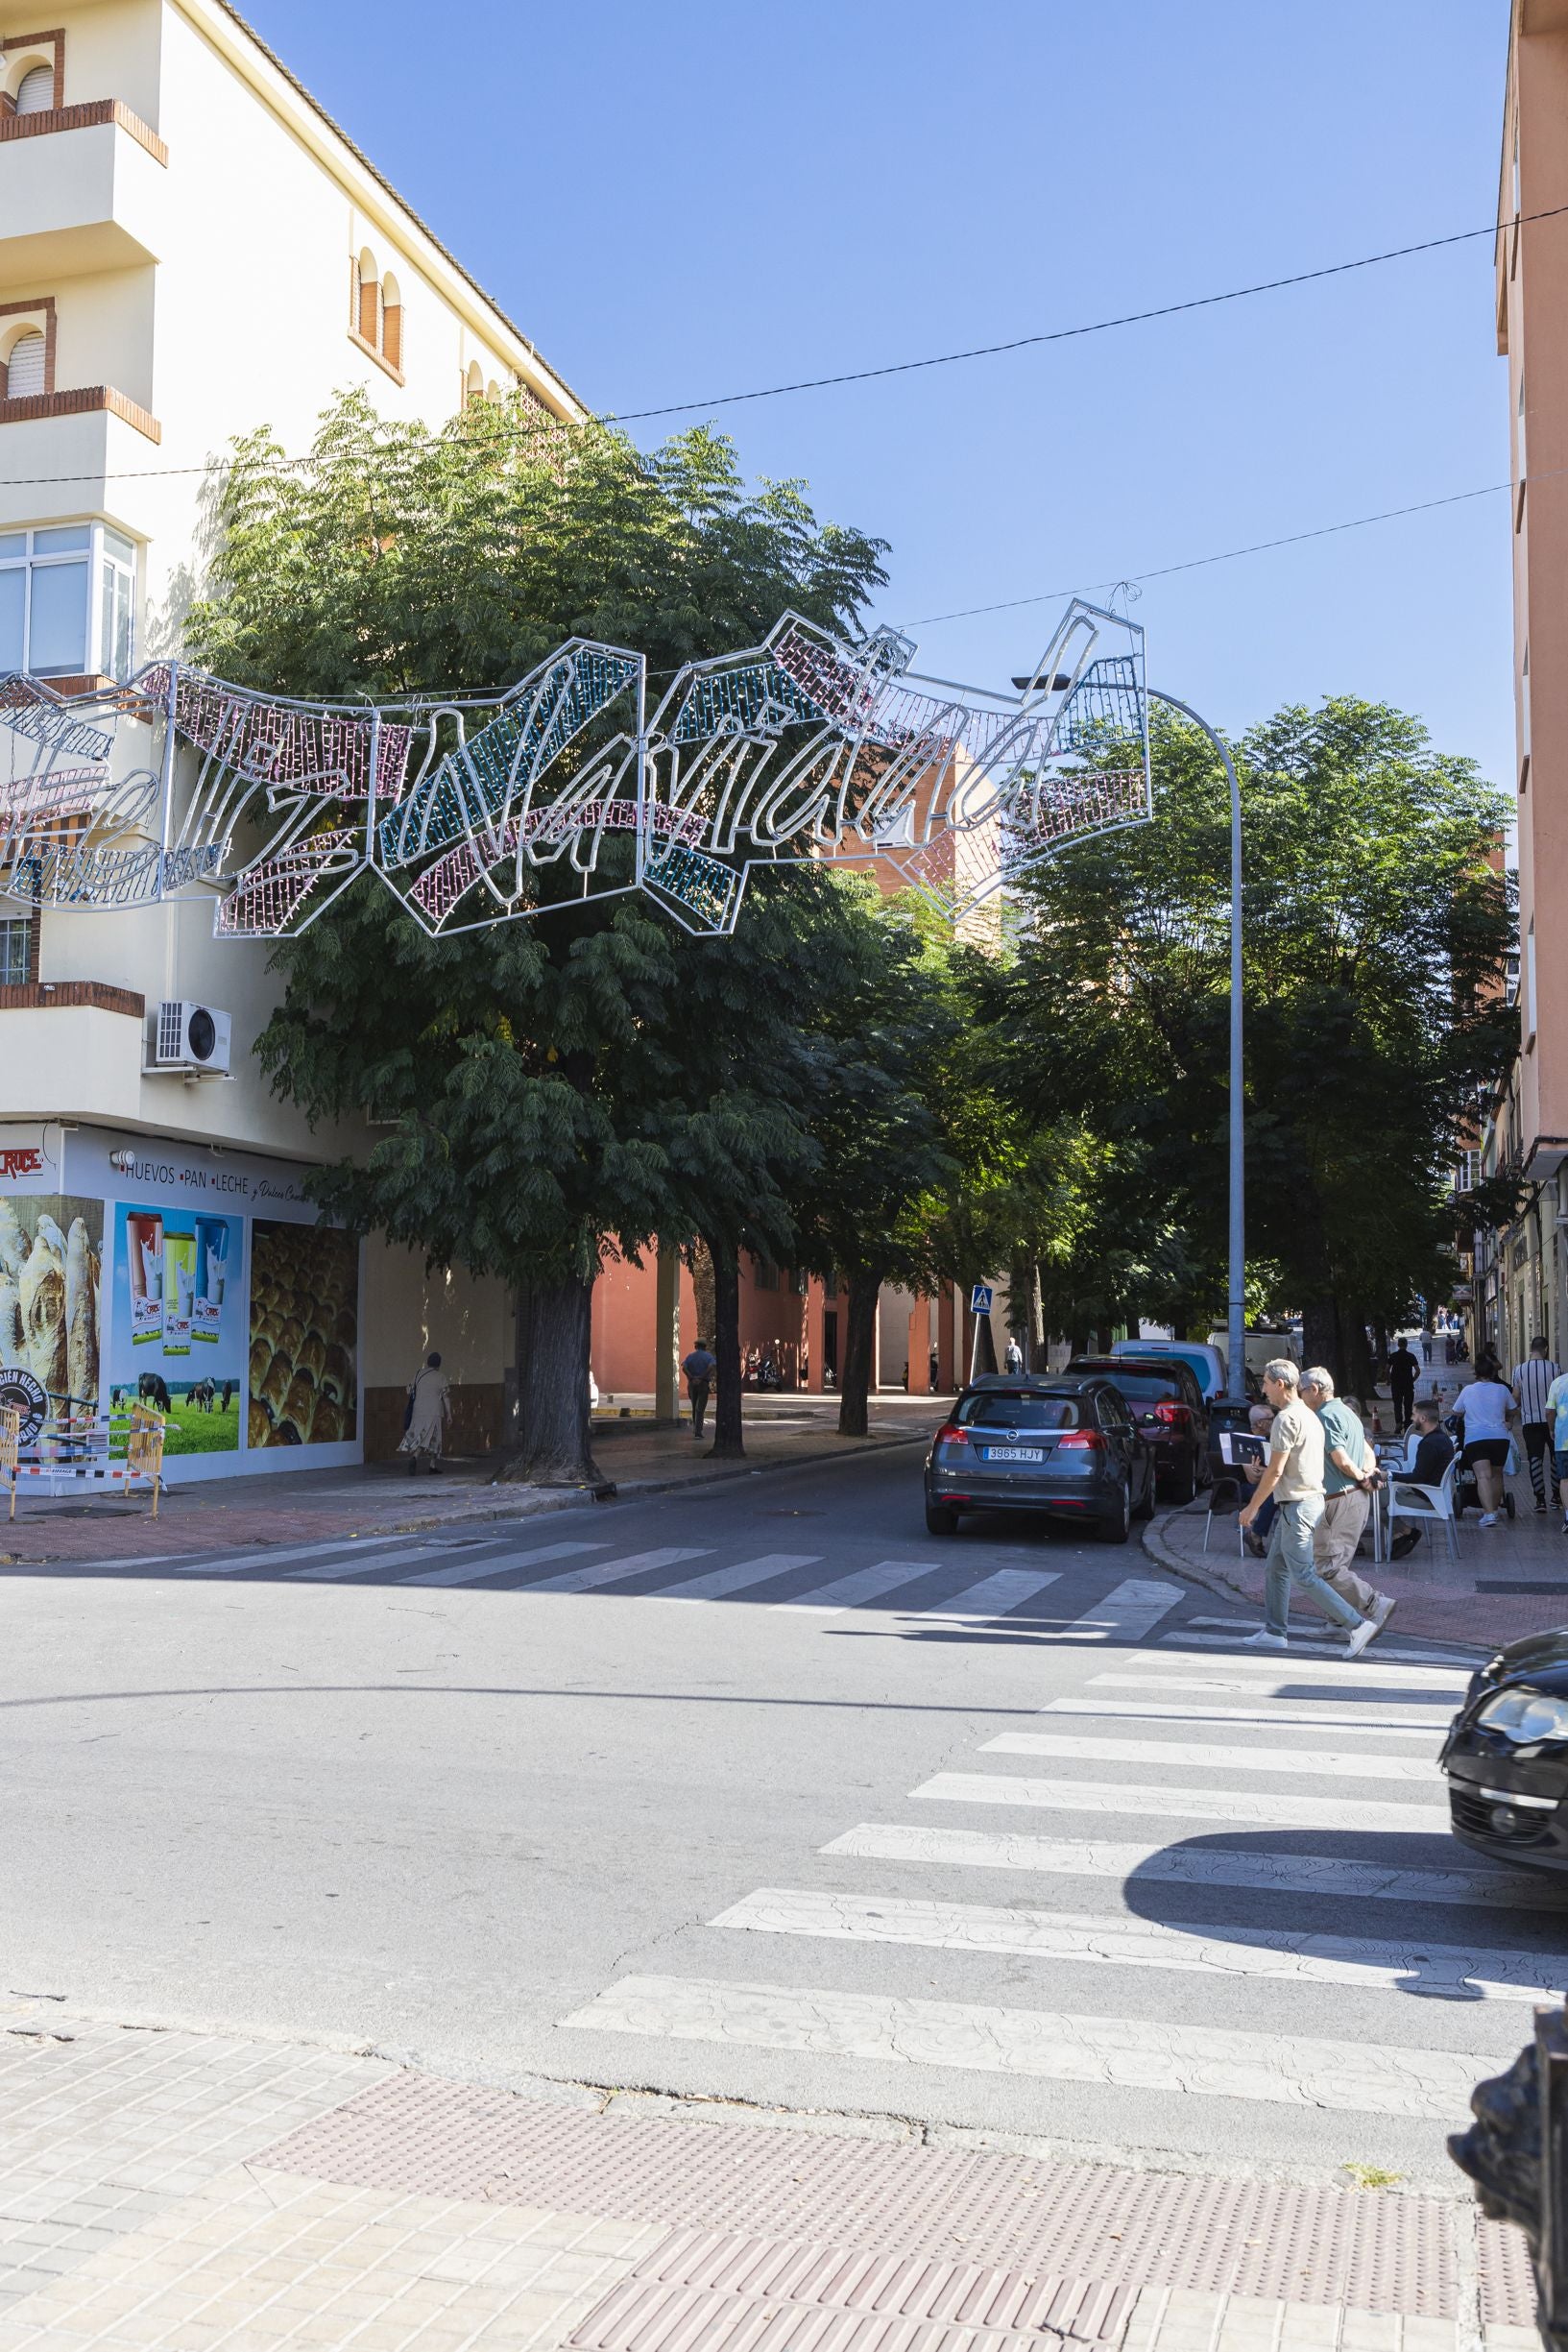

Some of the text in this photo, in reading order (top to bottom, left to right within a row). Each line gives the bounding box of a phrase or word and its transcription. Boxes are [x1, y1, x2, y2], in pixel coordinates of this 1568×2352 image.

[397, 616, 1101, 905] Navidad
[126, 1161, 175, 1184] HUEVOS
[184, 1169, 206, 1189] PAN
[215, 1173, 249, 1194] LECHE
[19, 1373, 43, 1403] HECHO
[990, 1448, 1040, 1459] 3965 HJY
